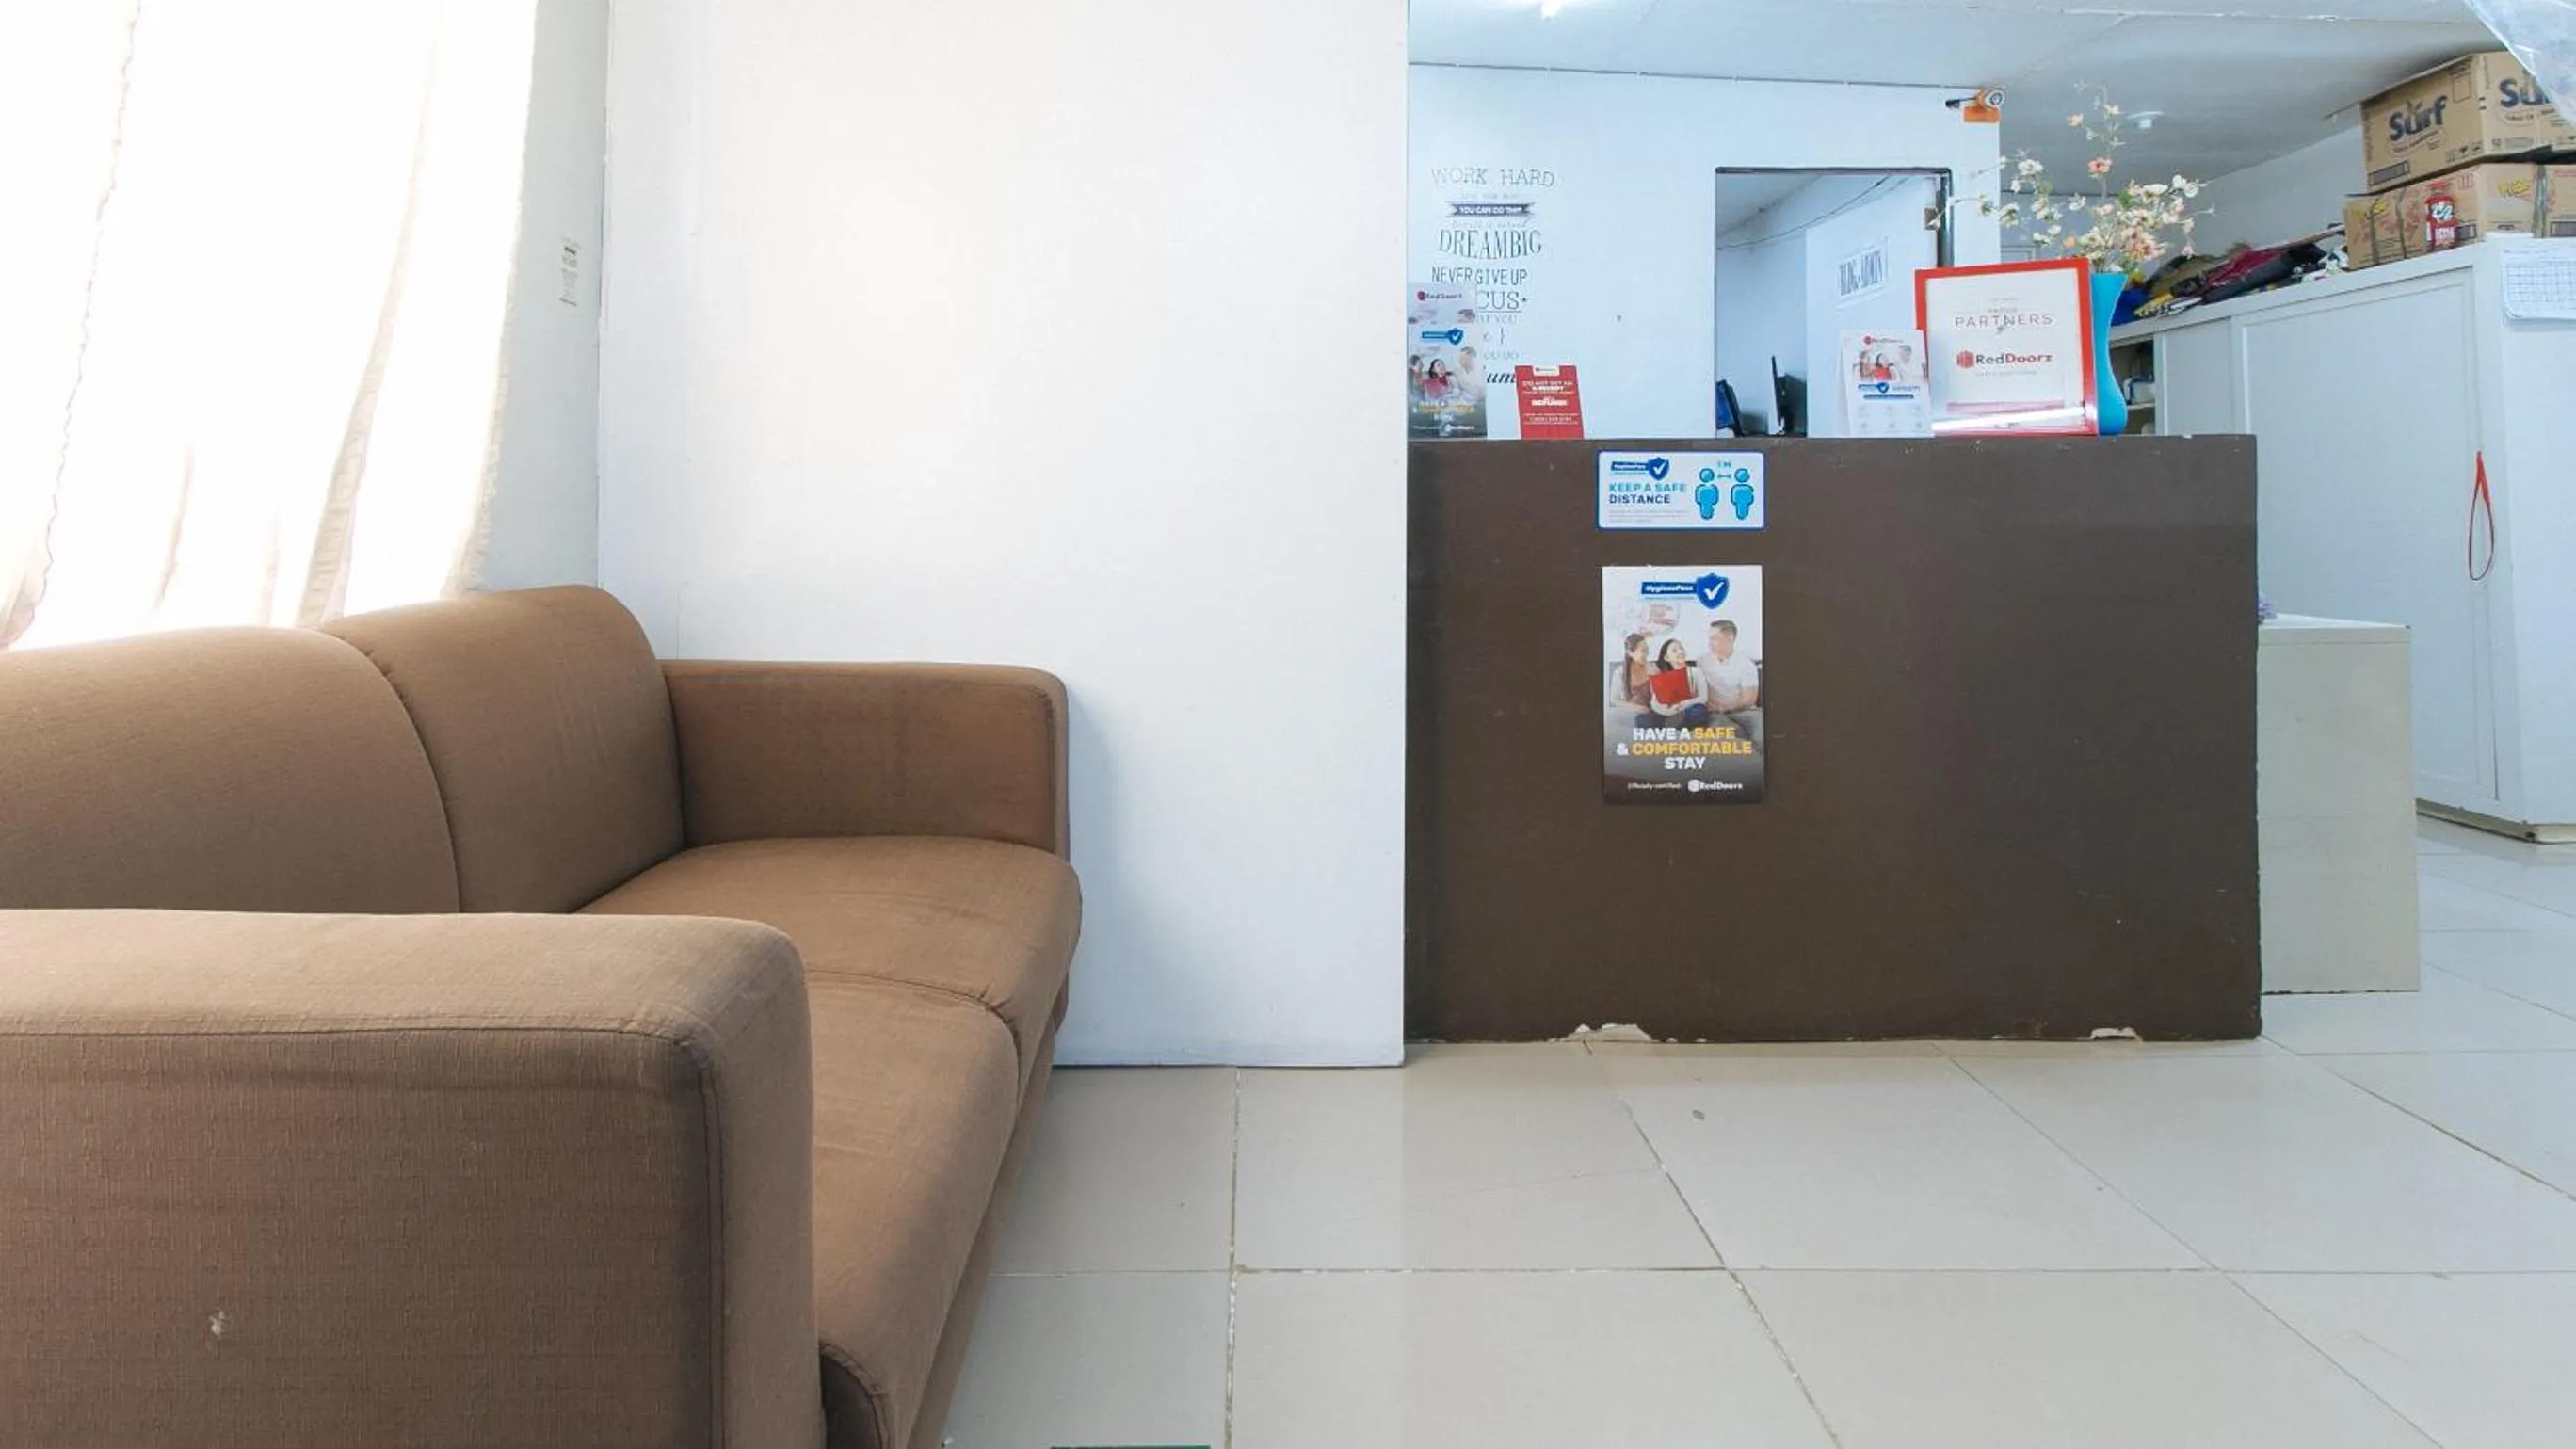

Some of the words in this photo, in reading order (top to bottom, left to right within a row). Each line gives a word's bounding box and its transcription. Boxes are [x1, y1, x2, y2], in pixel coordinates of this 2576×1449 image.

[2499, 78, 2551, 108] Su
[2389, 95, 2448, 141] Surf
[1430, 167, 1488, 185] WORK
[1500, 168, 1555, 187] HARD
[1431, 266, 1473, 282] NEVER
[1474, 268, 1508, 285] GIVE
[1510, 268, 1528, 285] UP
[1955, 313, 2053, 328] PARTNERS
[1975, 351, 2053, 364] RedDoorz
[1608, 483, 1640, 492] KEEP
[1642, 483, 1652, 492] A
[1654, 482, 1687, 492] SAFE
[1608, 494, 1671, 504] DISTANCE
[1633, 728, 1677, 741] HAVE
[1679, 728, 1691, 740] A
[1694, 727, 1736, 739] SAFE
[1616, 742, 1629, 756] &
[1632, 741, 1752, 755] COMFORTABLE
[1664, 756, 1706, 770] STAY
